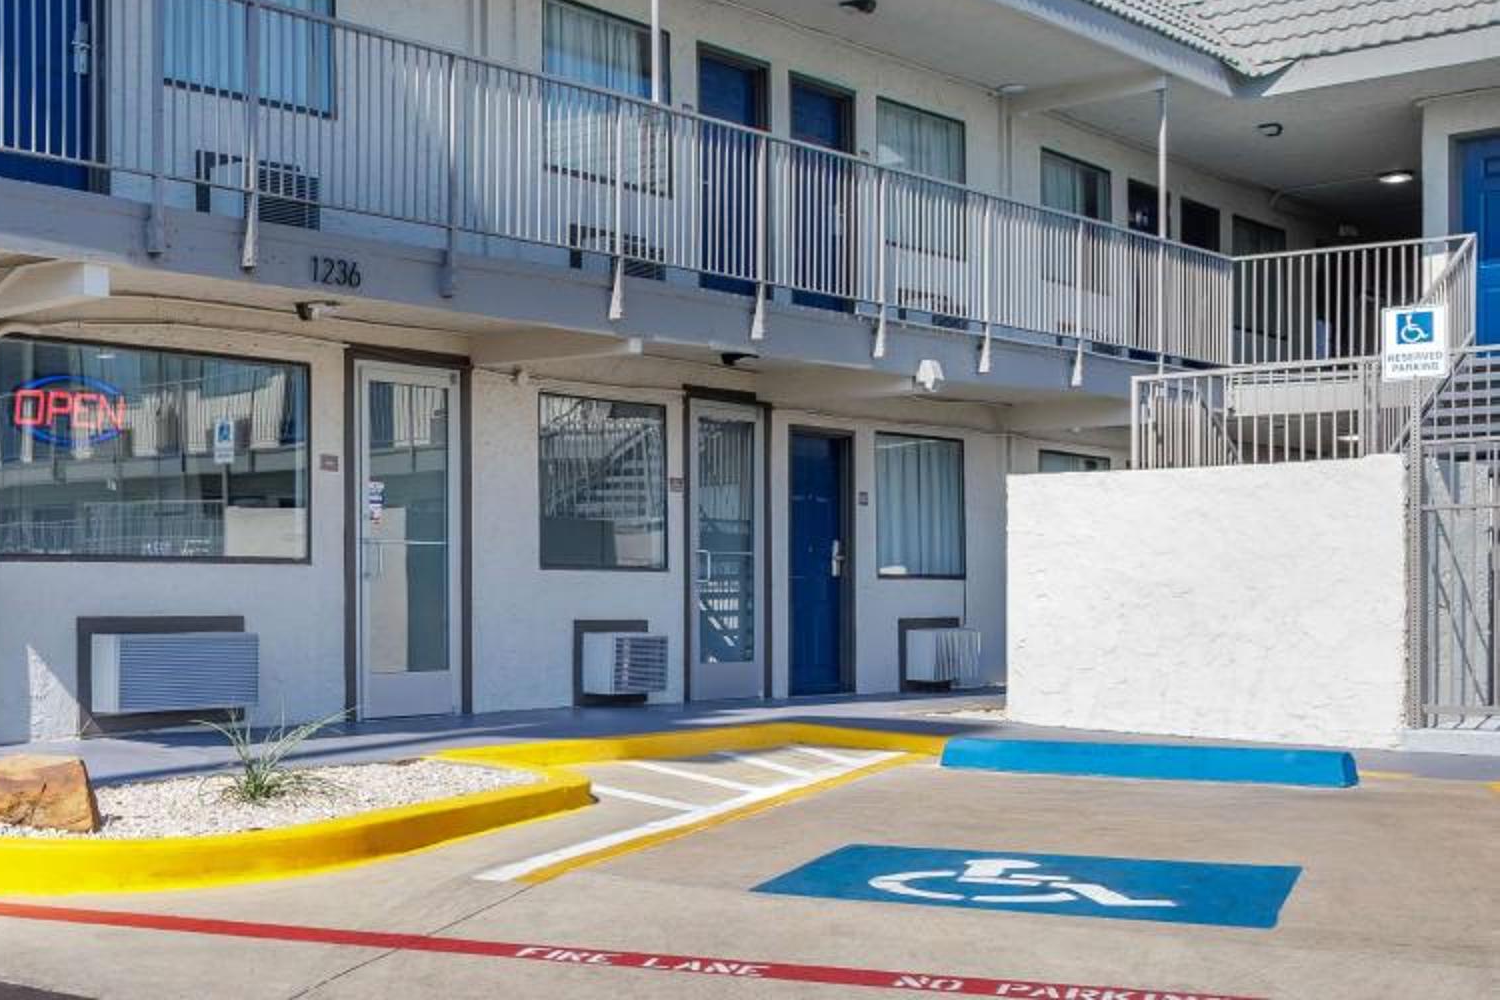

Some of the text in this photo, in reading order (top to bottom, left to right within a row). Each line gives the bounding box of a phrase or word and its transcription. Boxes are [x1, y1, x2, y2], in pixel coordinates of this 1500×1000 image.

[310, 256, 361, 287] 1236
[1387, 351, 1443, 362] RESERVED
[1391, 361, 1440, 372] PARKING
[14, 389, 126, 431] OPEN
[515, 946, 771, 977] FIRE LANE
[891, 975, 964, 991] NO
